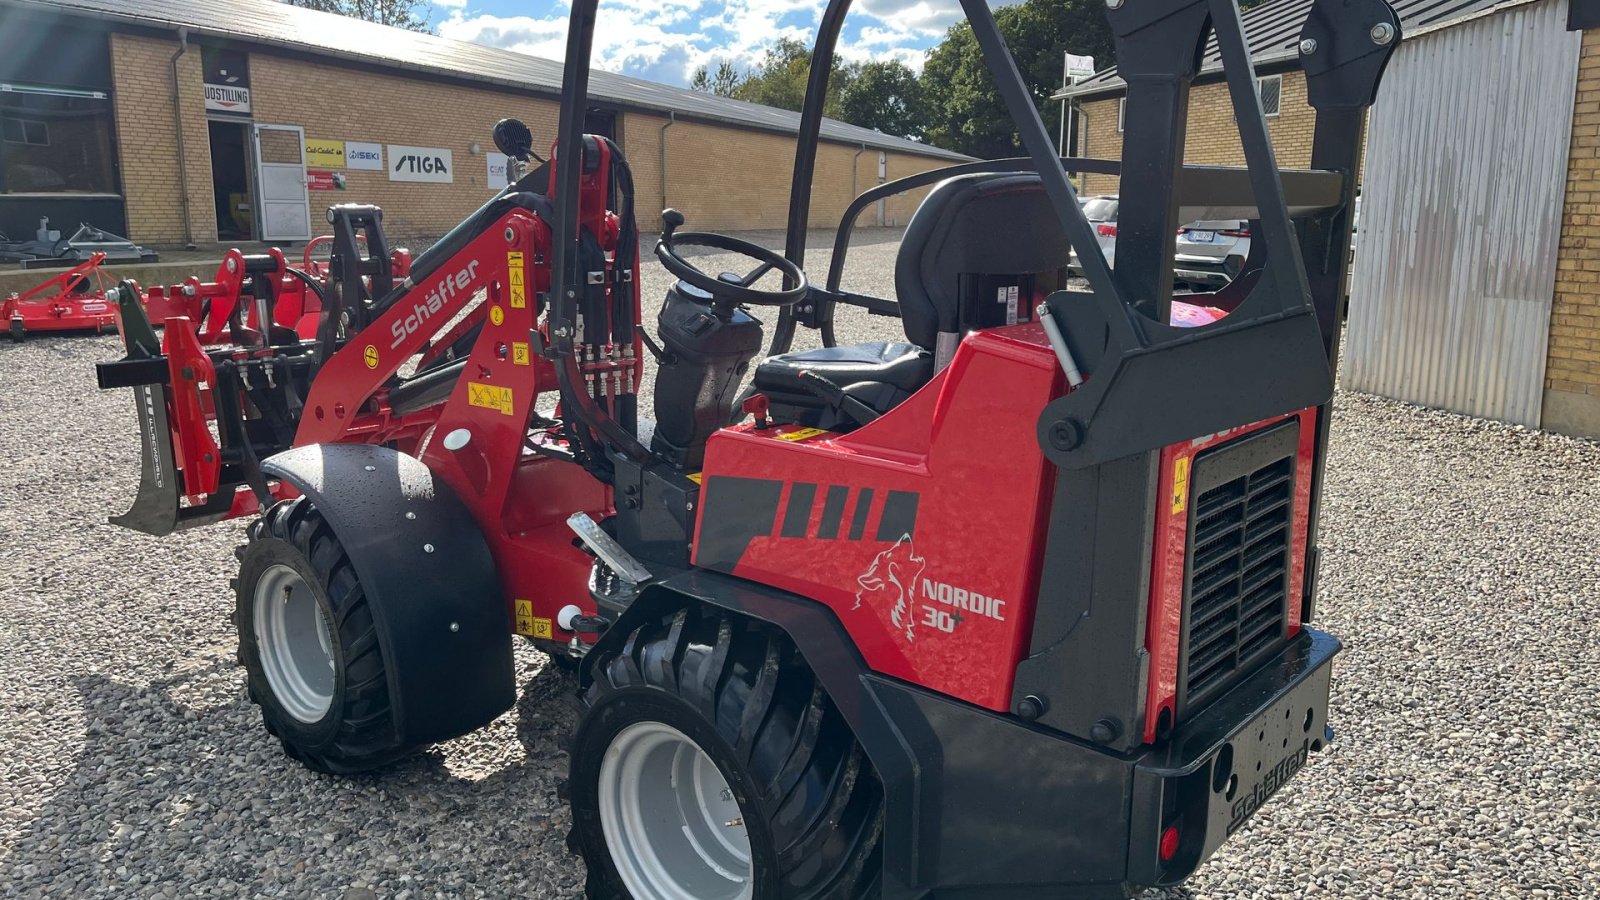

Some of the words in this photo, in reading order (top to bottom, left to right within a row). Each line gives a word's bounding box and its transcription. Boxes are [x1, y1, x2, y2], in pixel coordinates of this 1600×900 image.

[204, 86, 248, 104] UDSTILLING
[357, 151, 380, 160] ISEKI
[395, 155, 448, 174] STIGA
[391, 259, 479, 350] Schäffer
[922, 578, 1006, 622] NORDIC
[1226, 738, 1309, 838] Schäffer
